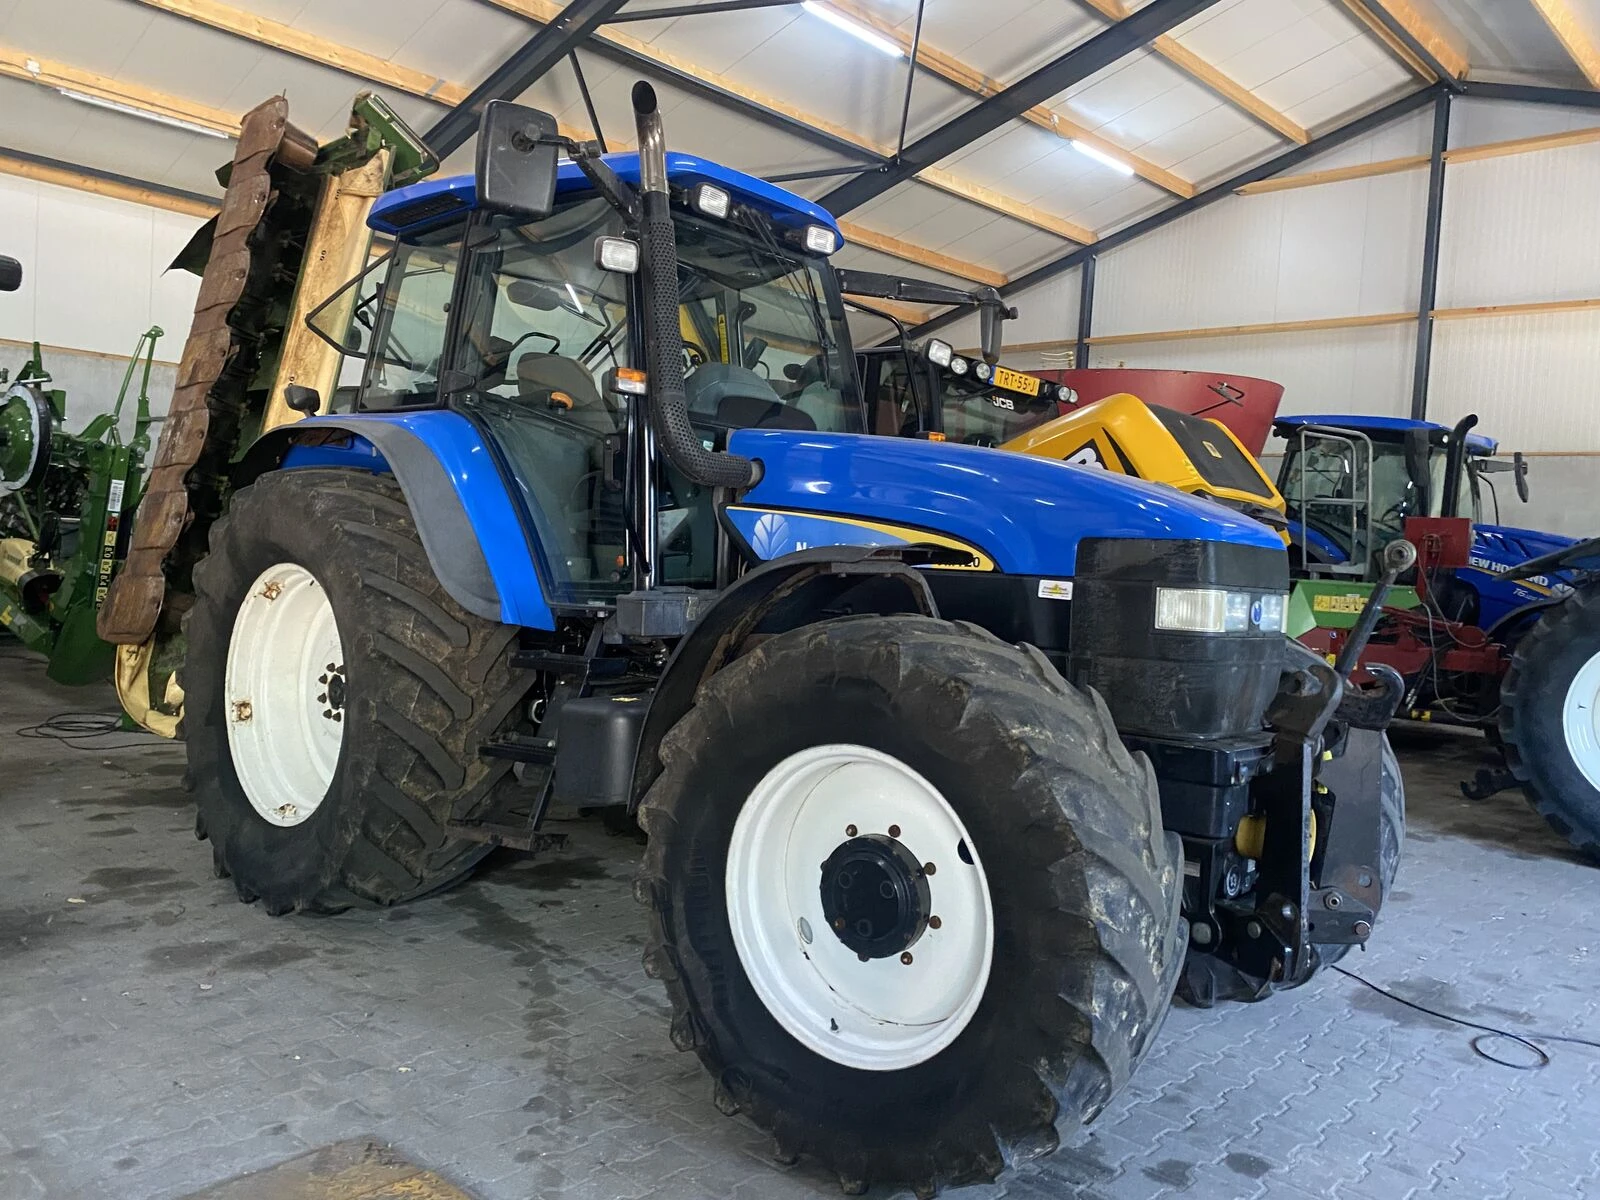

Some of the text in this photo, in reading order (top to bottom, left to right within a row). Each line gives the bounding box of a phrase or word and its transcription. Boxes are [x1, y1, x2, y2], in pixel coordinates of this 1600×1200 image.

[999, 370, 1036, 393] TRT-55-J
[992, 396, 1014, 410] JCB
[1491, 562, 1549, 587] HOND
